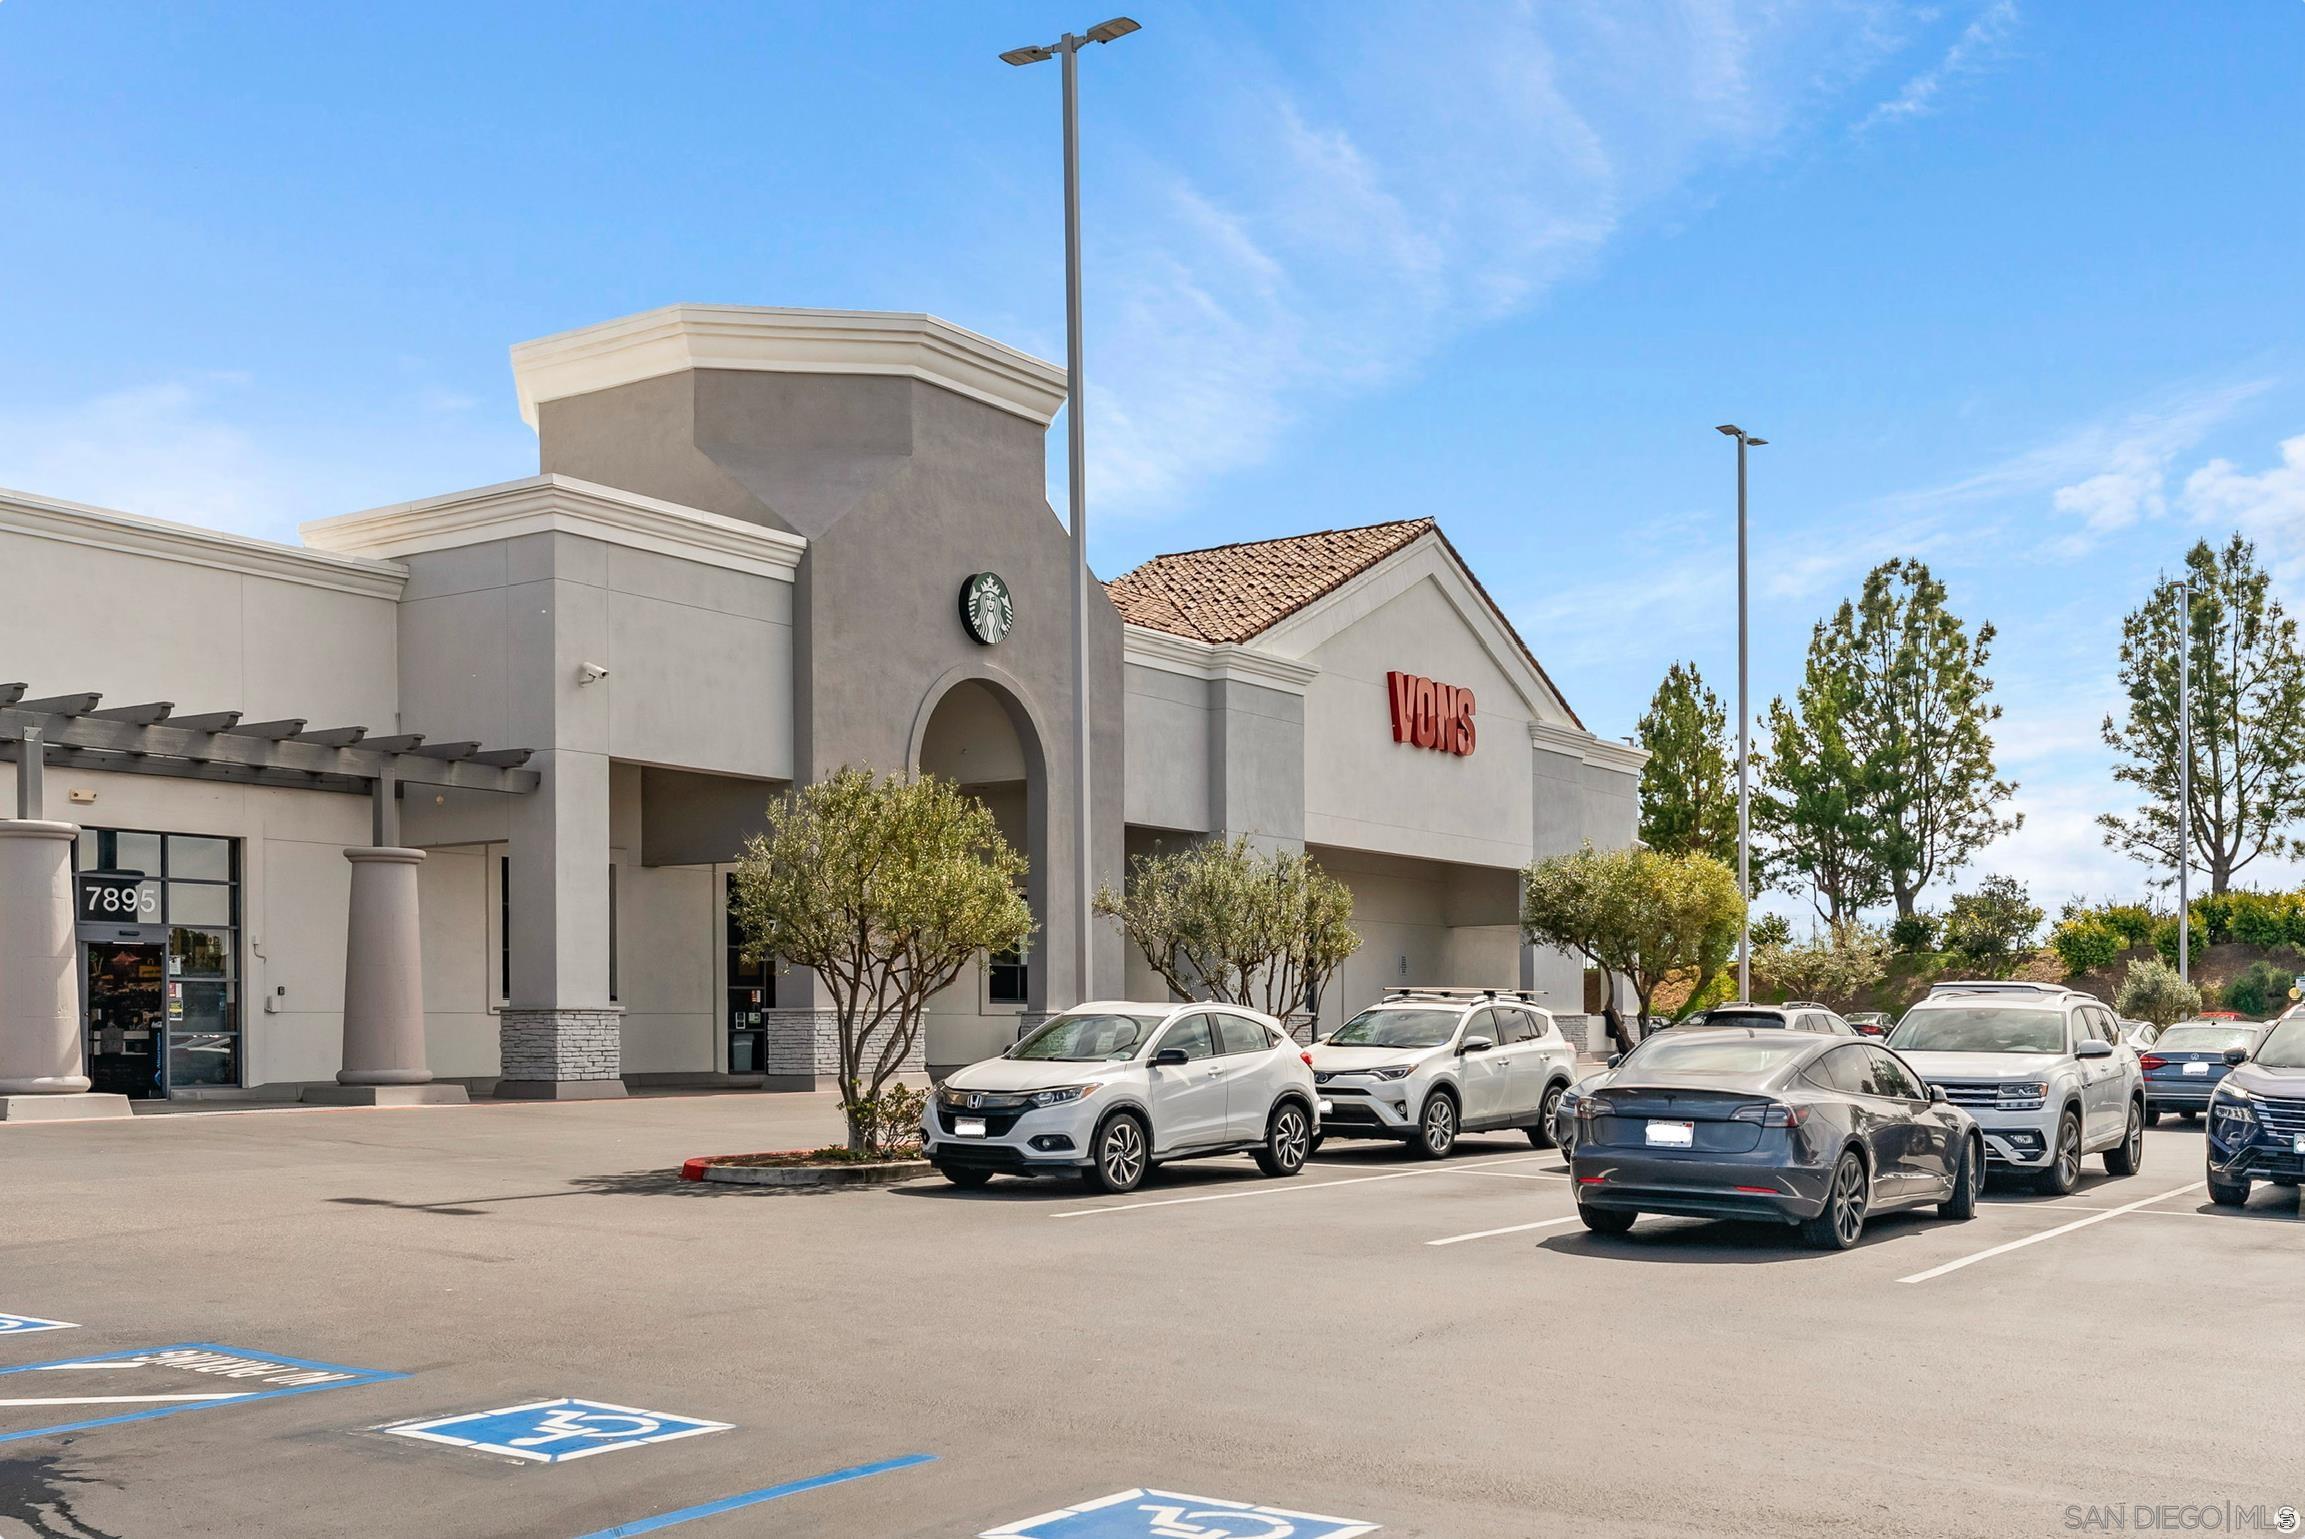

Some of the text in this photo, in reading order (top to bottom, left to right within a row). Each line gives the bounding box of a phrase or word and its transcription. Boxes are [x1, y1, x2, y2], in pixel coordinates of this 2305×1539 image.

[1387, 671, 1476, 756] VONS
[86, 886, 156, 912] 7895
[132, 1350, 356, 1386] NO PARKING
